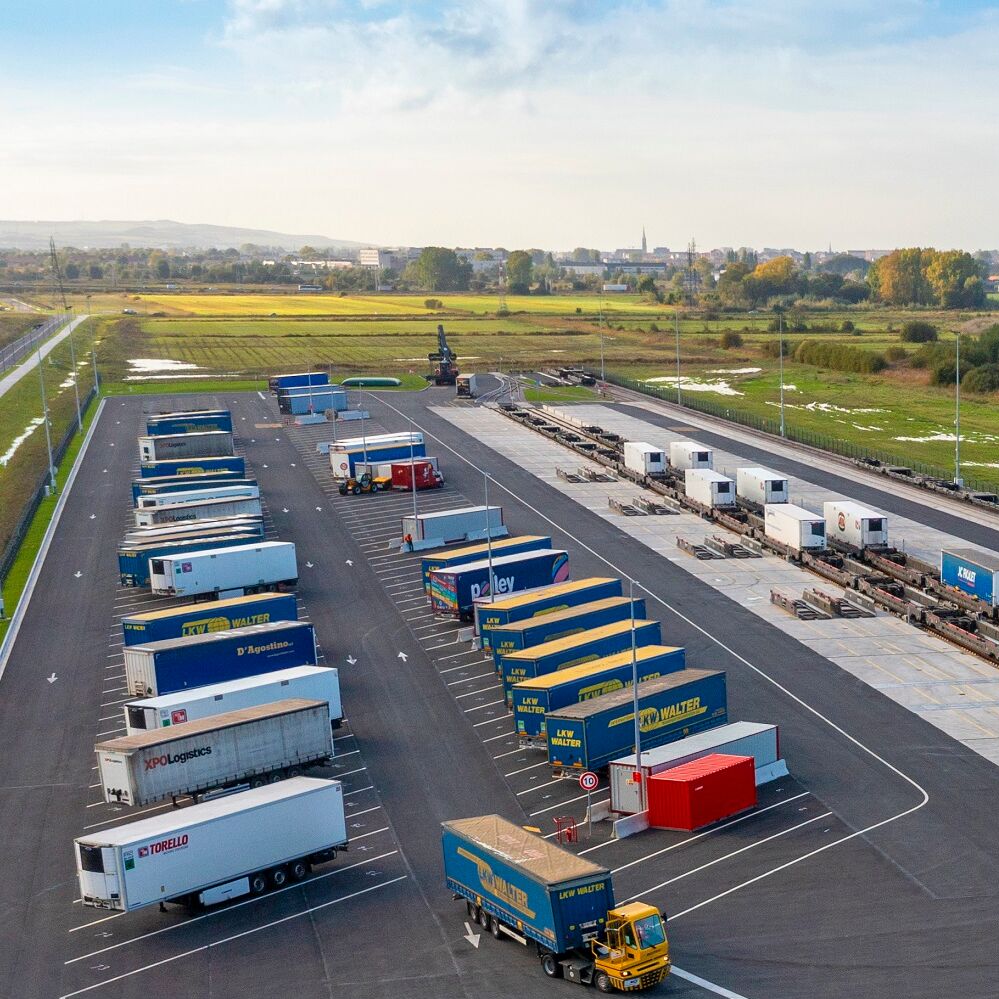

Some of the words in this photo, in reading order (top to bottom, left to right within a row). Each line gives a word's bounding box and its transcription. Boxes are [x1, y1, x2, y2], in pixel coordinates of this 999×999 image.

[231, 612, 271, 629] WALTER
[511, 668, 526, 676] LKW
[522, 697, 539, 705] LKW
[517, 705, 546, 714] WALTER
[660, 696, 701, 721] WALTER
[556, 729, 575, 738] LKW
[551, 738, 582, 748] WALTER
[583, 777, 594, 785] 10
[149, 834, 189, 856] TORELLO
[559, 889, 576, 900] LKW
[577, 882, 606, 896] WALTER
